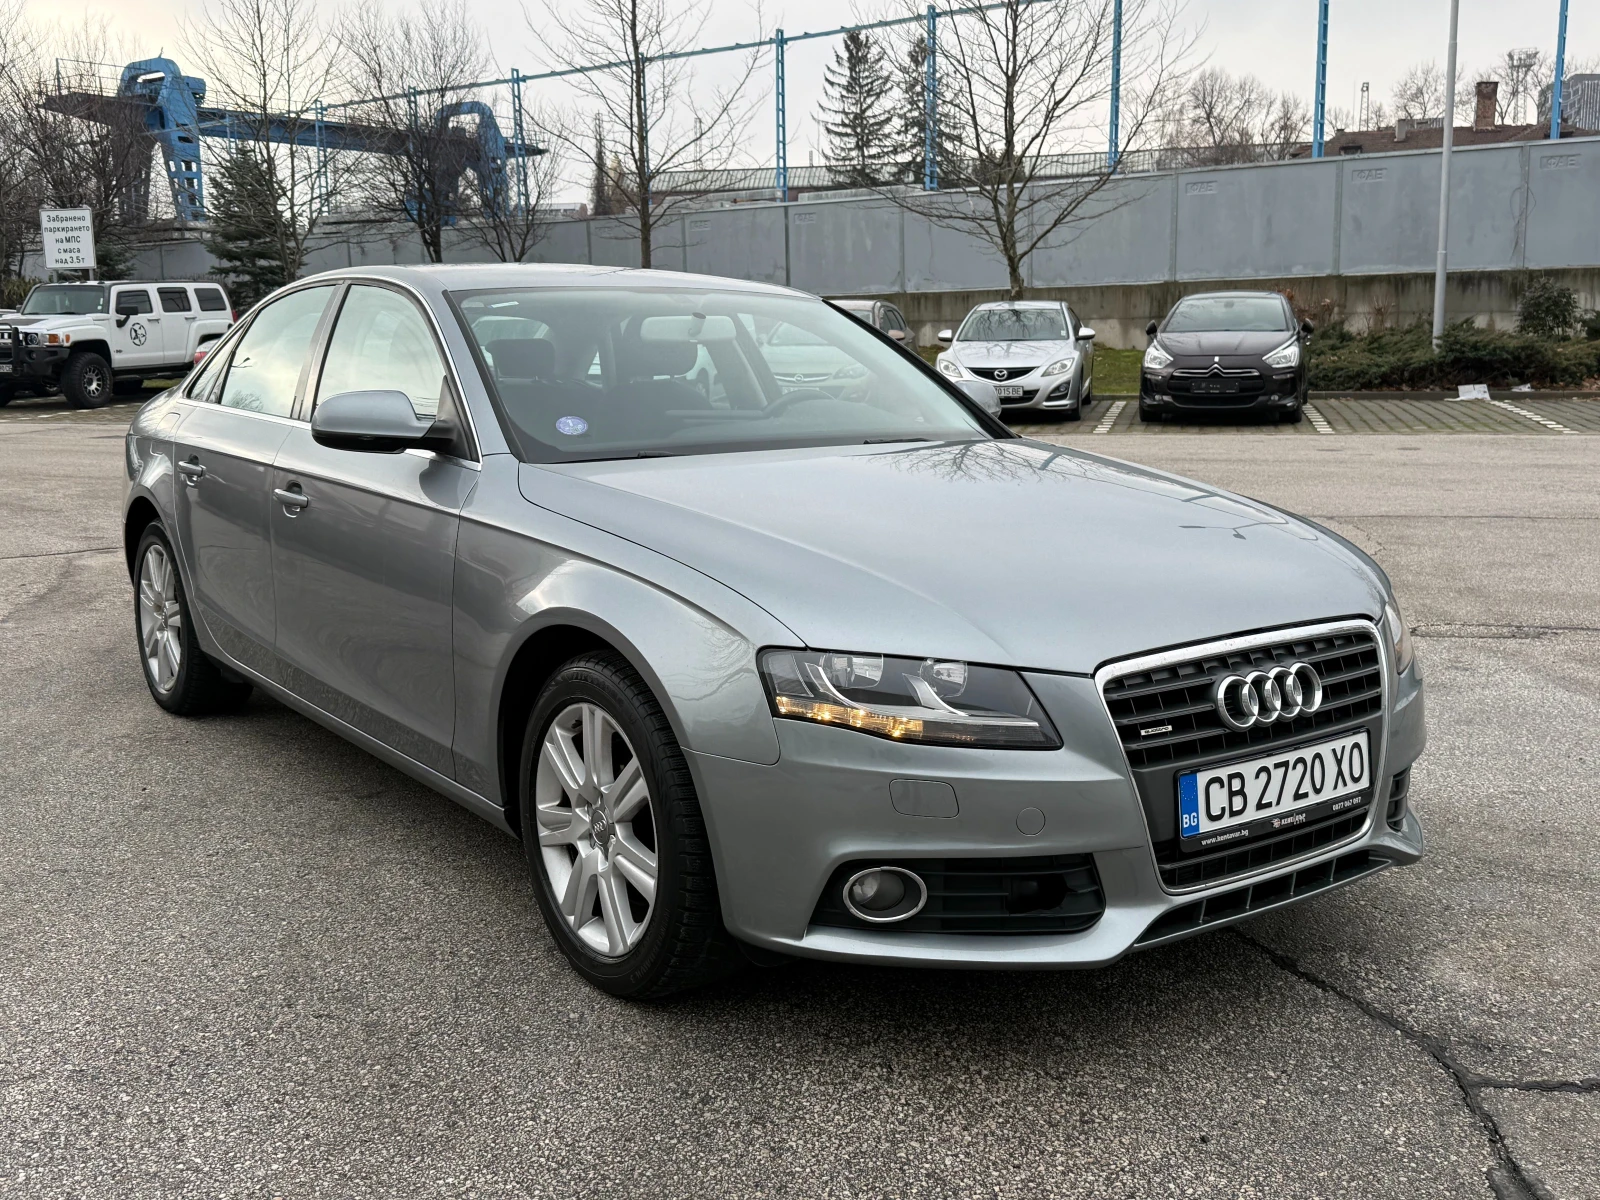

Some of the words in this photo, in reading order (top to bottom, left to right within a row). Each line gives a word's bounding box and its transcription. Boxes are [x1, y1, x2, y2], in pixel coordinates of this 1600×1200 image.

[46, 215, 86, 223] Забранено
[44, 225, 90, 234] паркирането
[64, 235, 81, 243] МПС
[995, 387, 1011, 395] 015
[1204, 772, 1248, 821] CB
[1254, 752, 1326, 812] 2720
[1332, 741, 1364, 790] XO
[1182, 812, 1198, 829] BG
[1201, 829, 1249, 846] www.kentavar.bg
